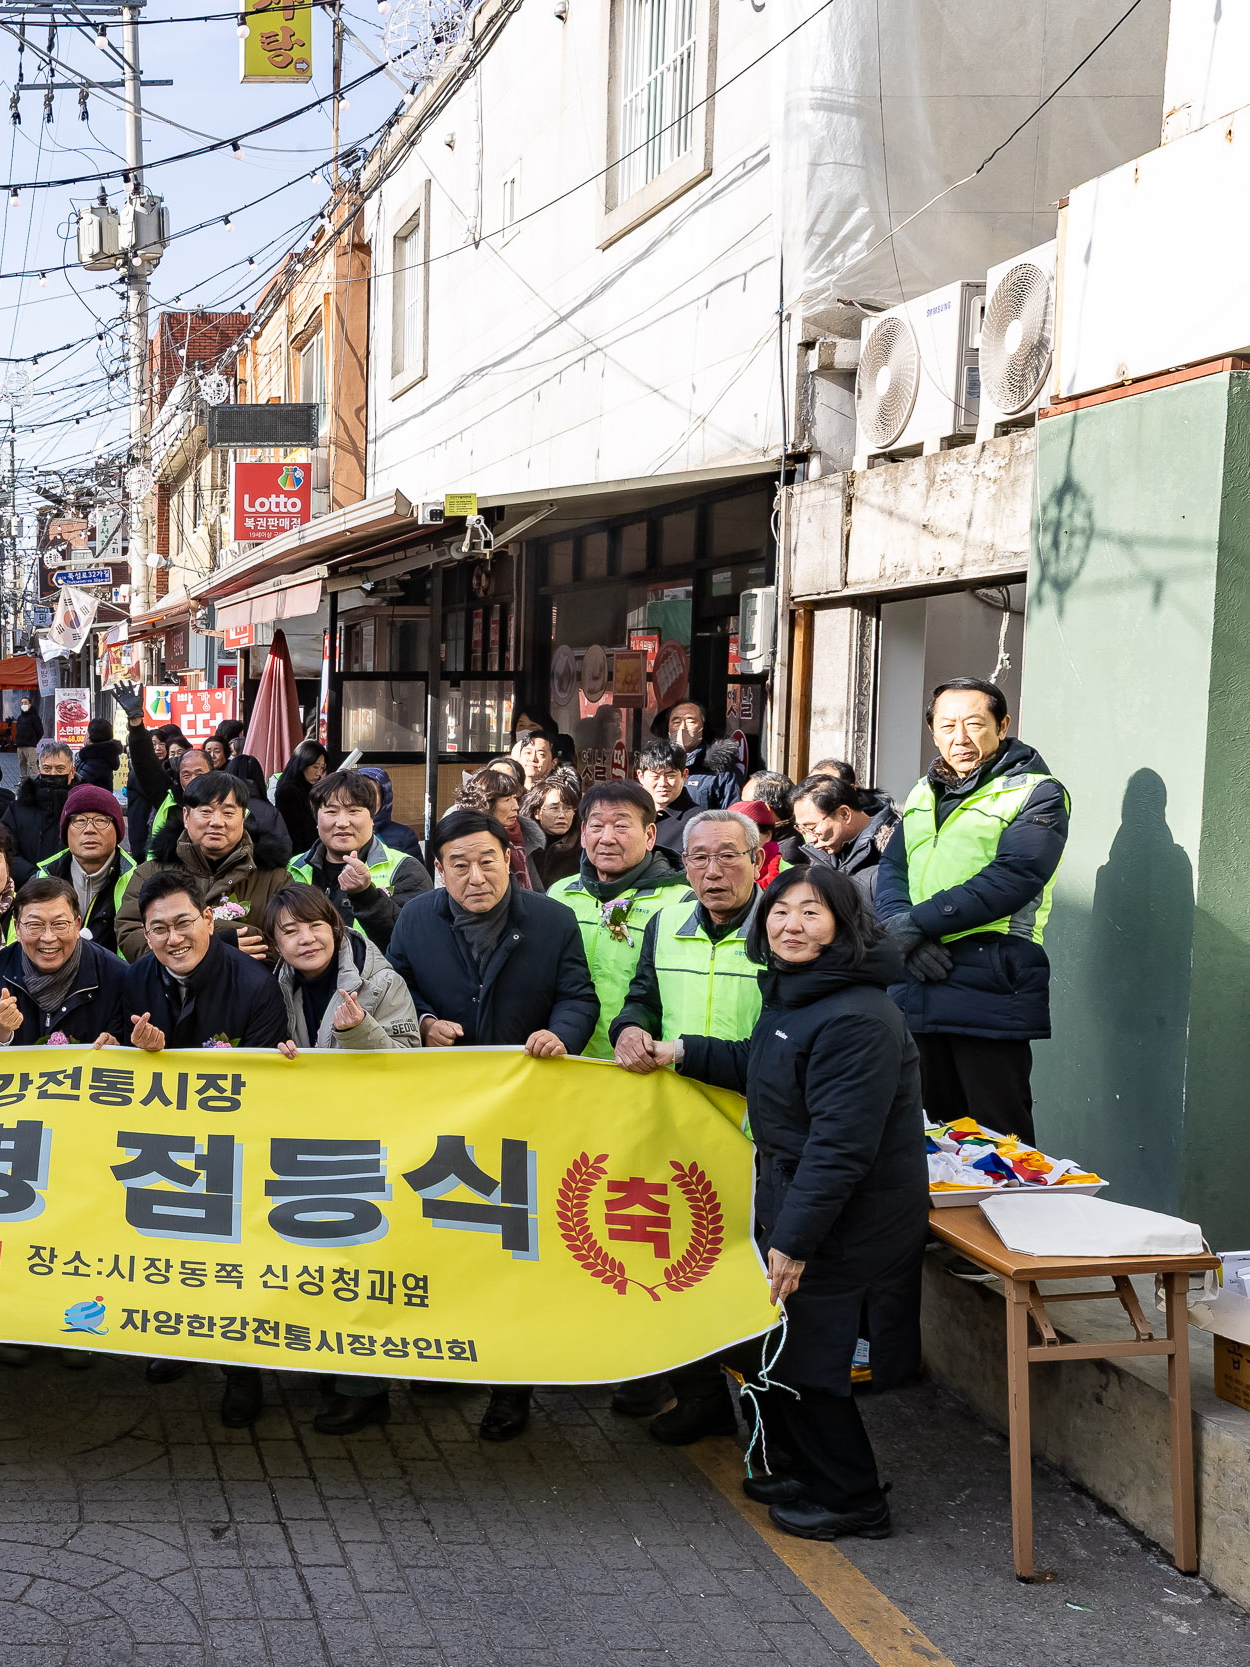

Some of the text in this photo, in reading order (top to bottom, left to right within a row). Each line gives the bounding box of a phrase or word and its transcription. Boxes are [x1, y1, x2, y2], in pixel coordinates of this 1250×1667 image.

[926, 301, 951, 318] SAMSUNG
[244, 494, 302, 513] Lotto
[244, 517, 301, 530] 복권판매점
[67, 570, 110, 580] 뚝섬로32가길
[392, 1023, 418, 1035] SEOUL
[110, 1131, 537, 1259] 점등식
[604, 1176, 671, 1259] 축
[27, 1244, 429, 1308] 장소:시장동쪽 신성청과옆
[119, 1306, 478, 1364] 자양한강전통시장상인회
